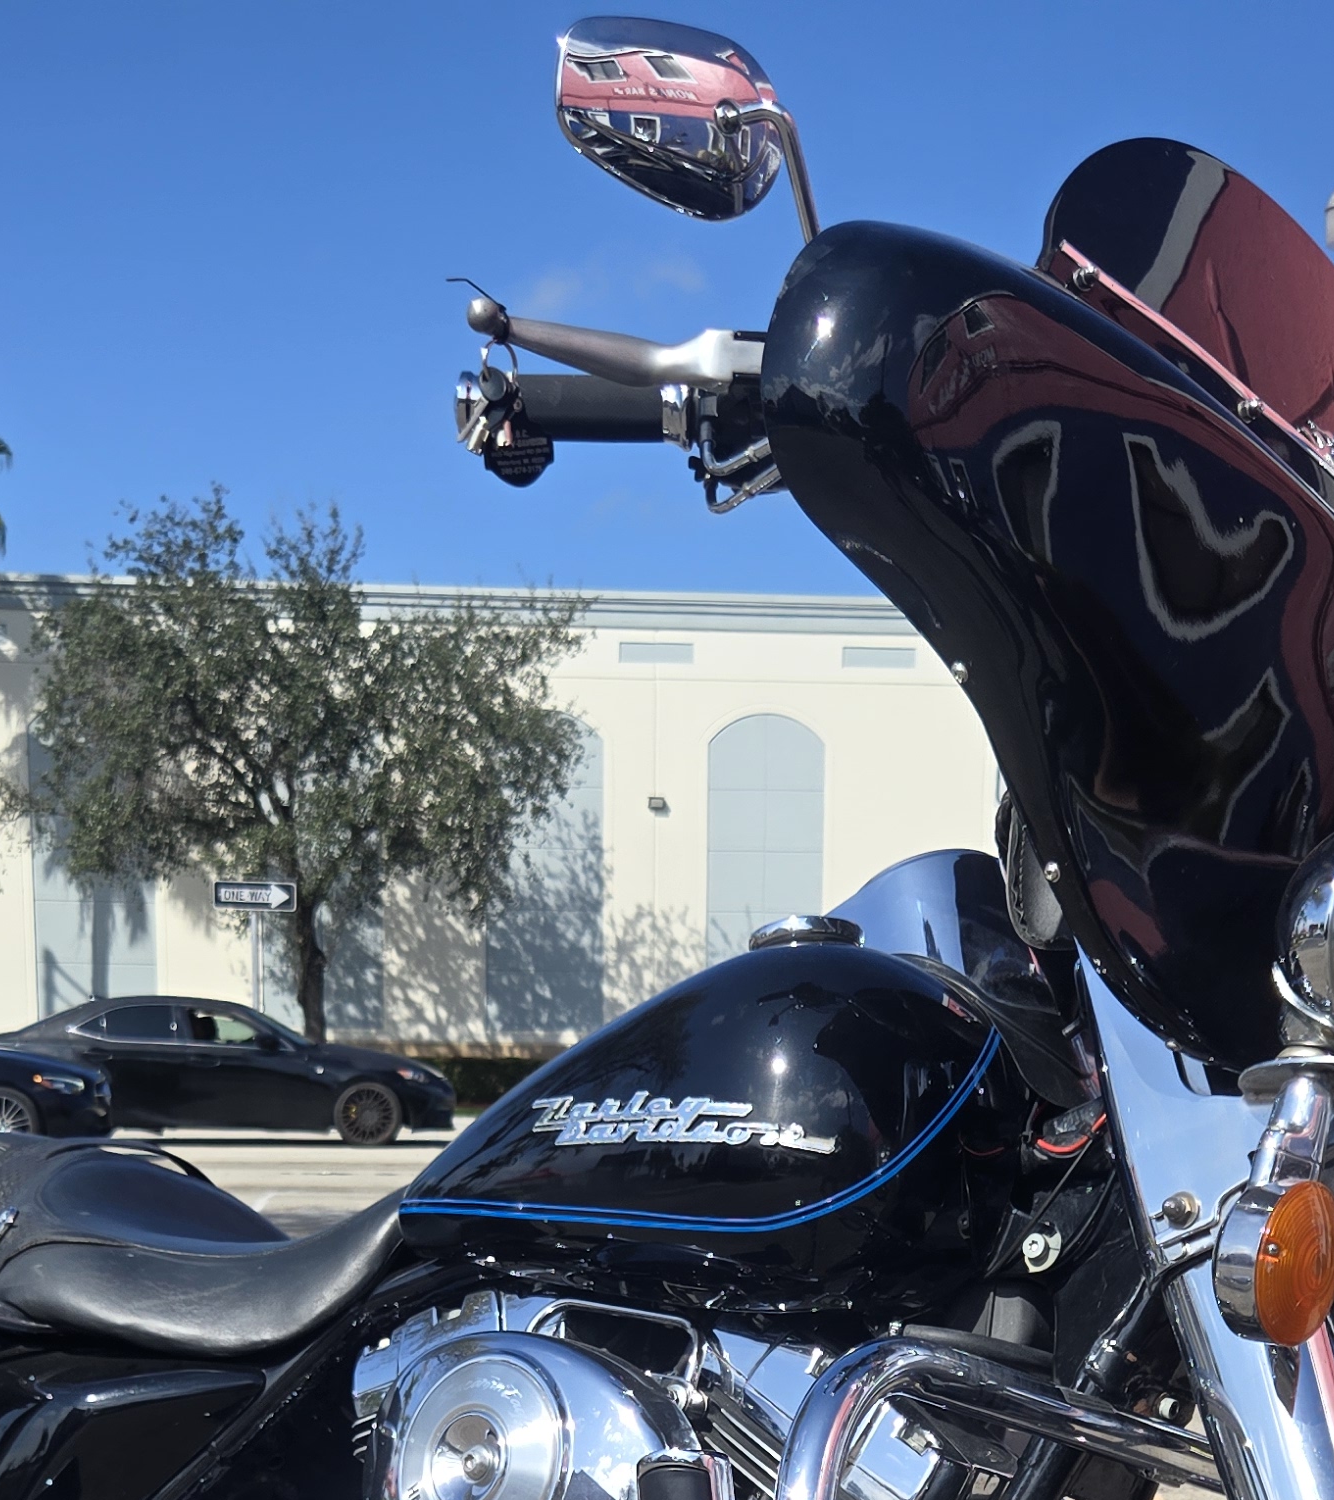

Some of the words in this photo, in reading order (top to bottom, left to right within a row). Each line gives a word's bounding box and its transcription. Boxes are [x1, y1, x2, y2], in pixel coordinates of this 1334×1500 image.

[224, 890, 246, 901] ONE
[248, 890, 271, 902] WAY
[532, 1090, 753, 1133] Harley
[555, 1117, 836, 1154] Davidson
